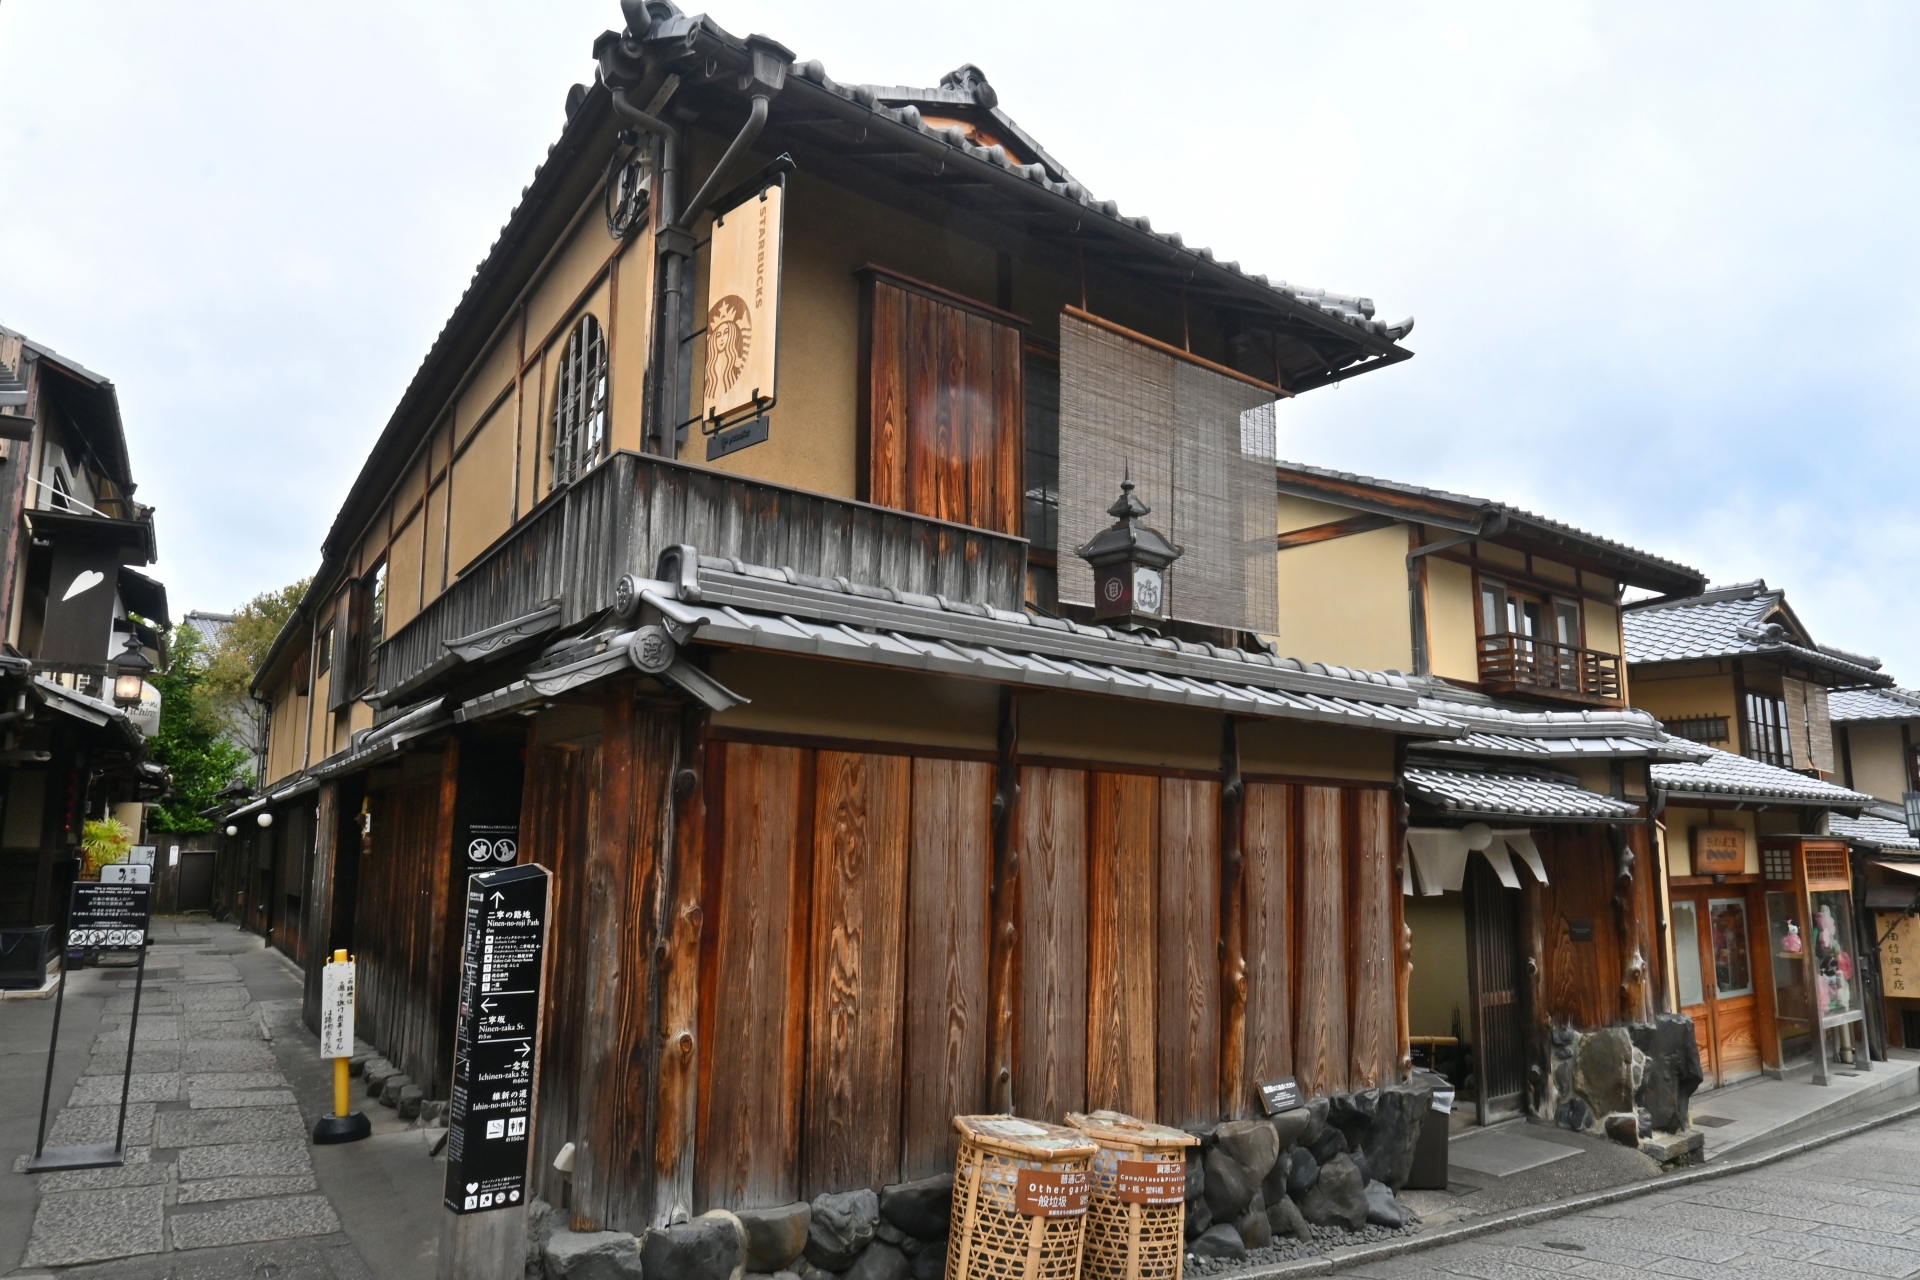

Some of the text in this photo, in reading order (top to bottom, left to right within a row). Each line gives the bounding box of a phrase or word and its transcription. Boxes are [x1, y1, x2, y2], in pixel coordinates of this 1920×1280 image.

[755, 206, 766, 309] STARBUCKS
[487, 910, 531, 919] 二寧の路地
[487, 920, 526, 928] Ninen-no-roji
[336, 982, 345, 1050] 通り抜け出来ません
[479, 1015, 506, 1025] 二寧坂
[479, 1024, 515, 1033] Ninen-zaka
[504, 1060, 530, 1070] 一念坂
[478, 1071, 519, 1081] Ichinen-zaka
[492, 1089, 528, 1101] 維新の道
[473, 1100, 518, 1111] Ishin-no-michi
[1157, 1164, 1180, 1174] 資源ごみ
[1061, 1174, 1086, 1184] 普通ごみ
[1029, 1183, 1065, 1196] Other
[1027, 1195, 1067, 1207] 一般垃圾
